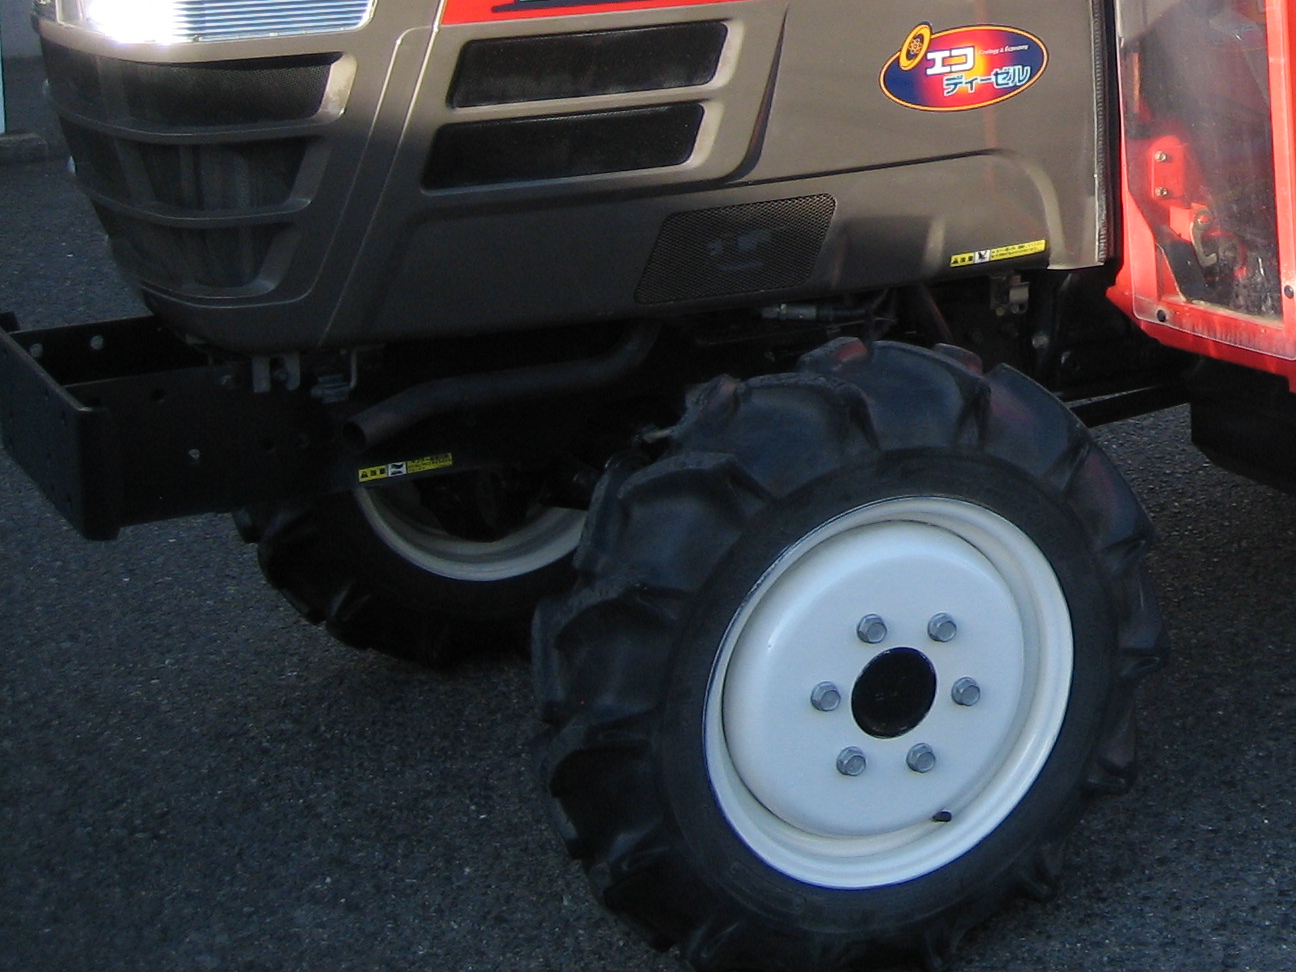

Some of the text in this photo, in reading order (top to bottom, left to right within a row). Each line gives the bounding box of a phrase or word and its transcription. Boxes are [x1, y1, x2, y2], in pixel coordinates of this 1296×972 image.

[925, 45, 976, 76] エコ
[943, 65, 1032, 96] ディーゼル
